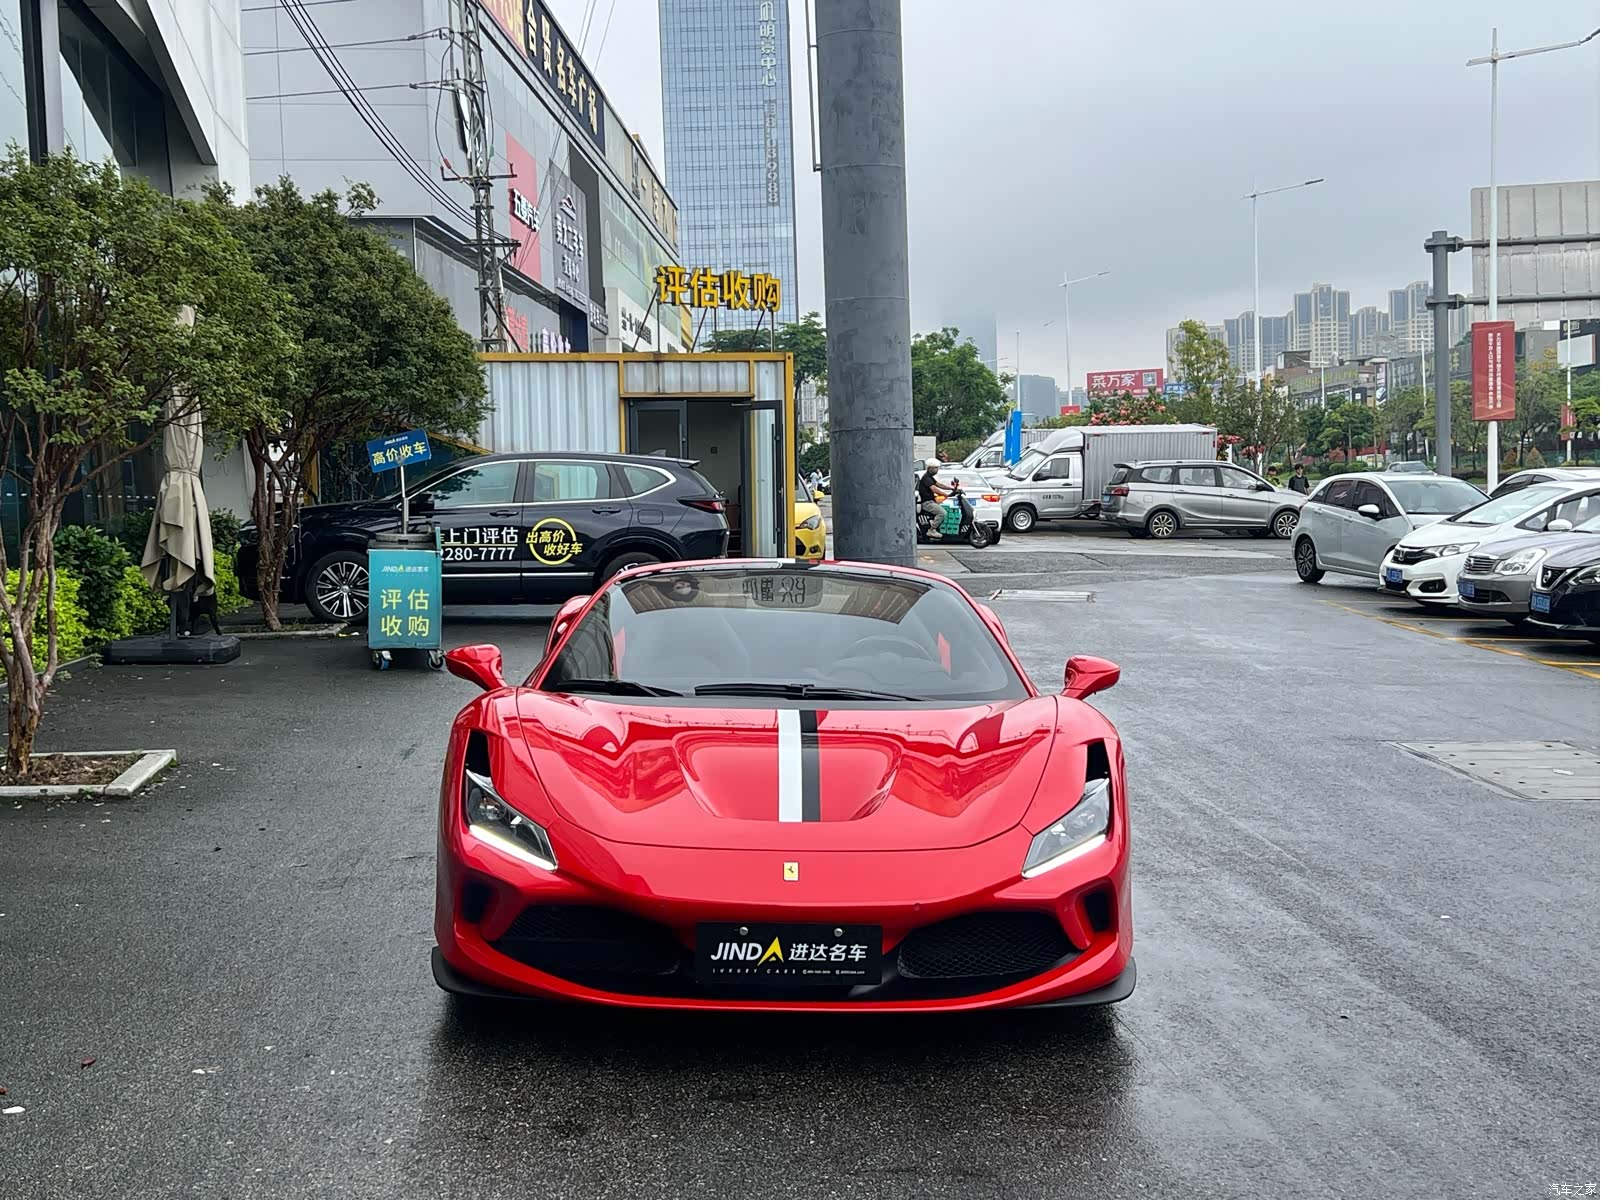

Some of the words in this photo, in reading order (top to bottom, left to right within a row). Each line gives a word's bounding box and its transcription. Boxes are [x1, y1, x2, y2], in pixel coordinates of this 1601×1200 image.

[760, 25, 777, 87] 明景中心
[655, 265, 782, 313] 评估收购
[1092, 374, 1135, 388] 菜万家
[371, 441, 428, 465] 高价收车
[525, 529, 566, 545] 出高价
[543, 541, 583, 557] 收好车
[710, 936, 785, 967] JINDA
[788, 943, 868, 962] 进达名车
